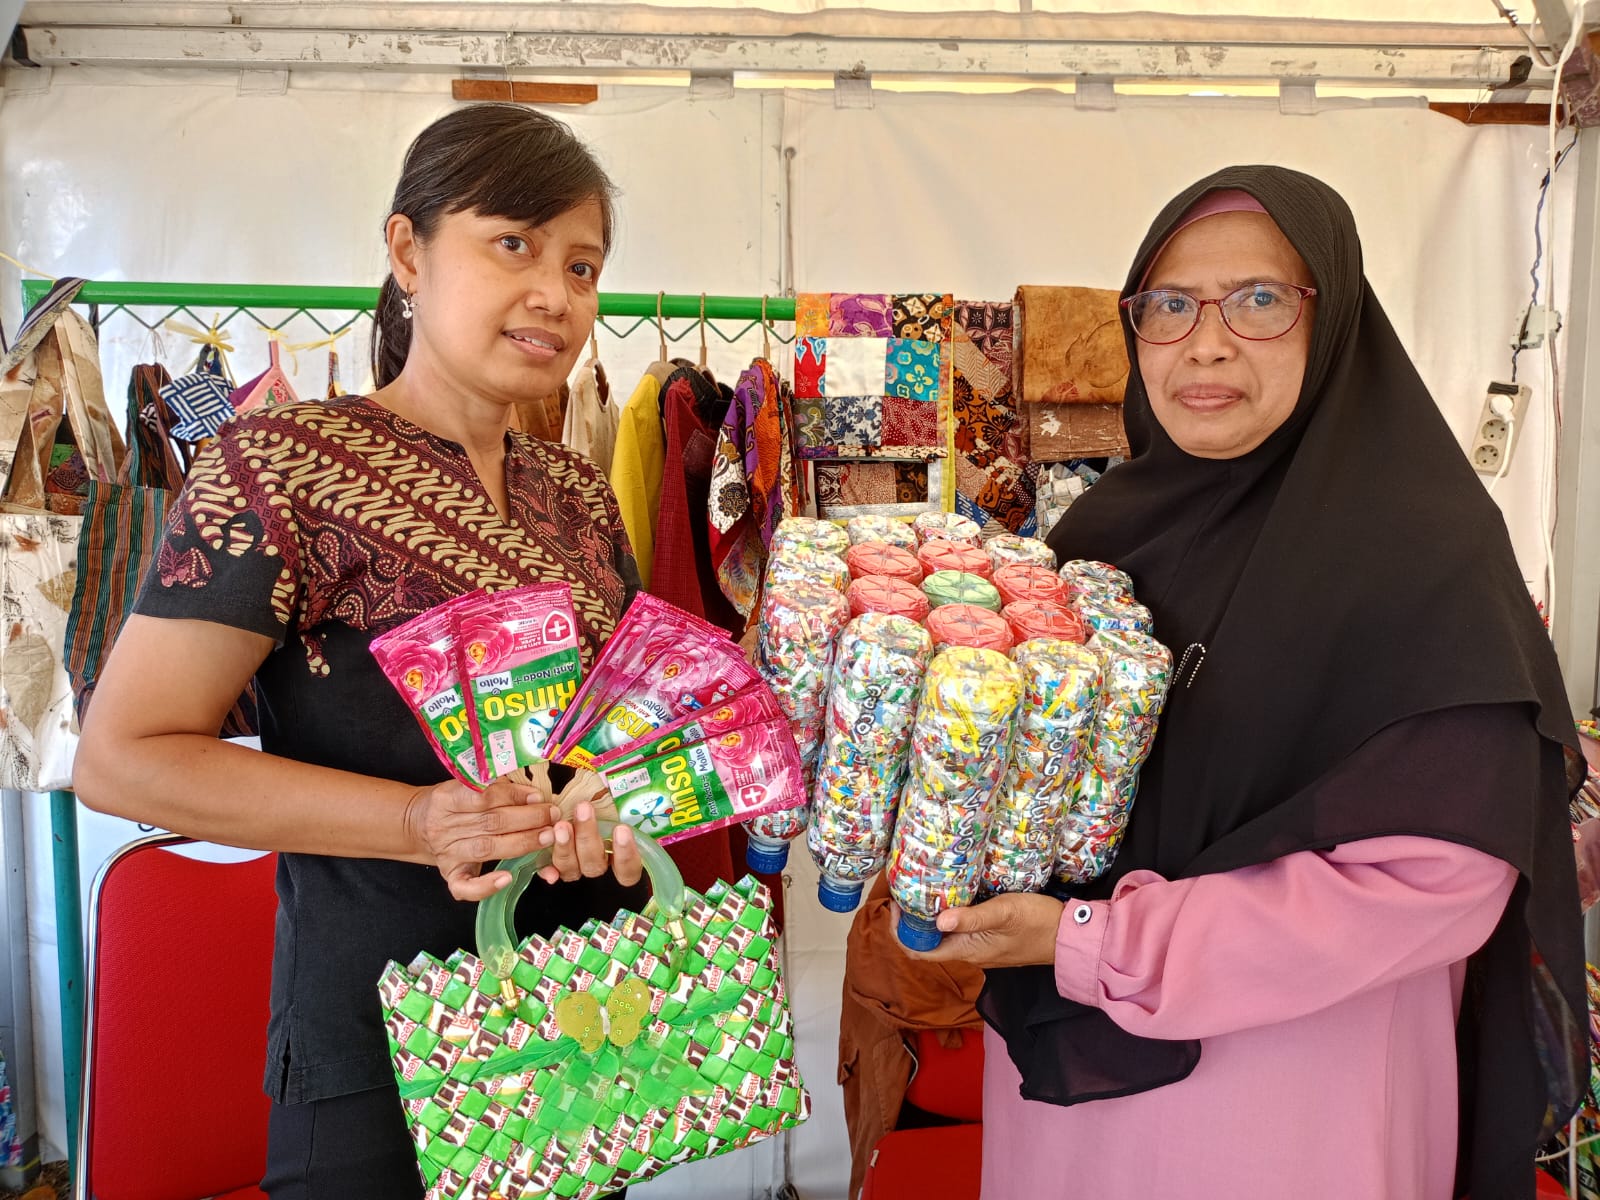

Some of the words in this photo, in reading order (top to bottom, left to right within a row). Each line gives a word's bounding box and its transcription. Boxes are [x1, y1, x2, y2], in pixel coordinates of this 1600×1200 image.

[524, 670, 551, 682] Noda
[554, 662, 575, 675] Anti
[479, 677, 509, 688] Molto
[428, 694, 456, 713] Molto
[483, 679, 577, 721] Rinso
[642, 699, 667, 721] Molto
[607, 705, 655, 739] inso
[689, 727, 702, 740] olto
[695, 748, 709, 772] Molto
[661, 755, 703, 827] Rinso
